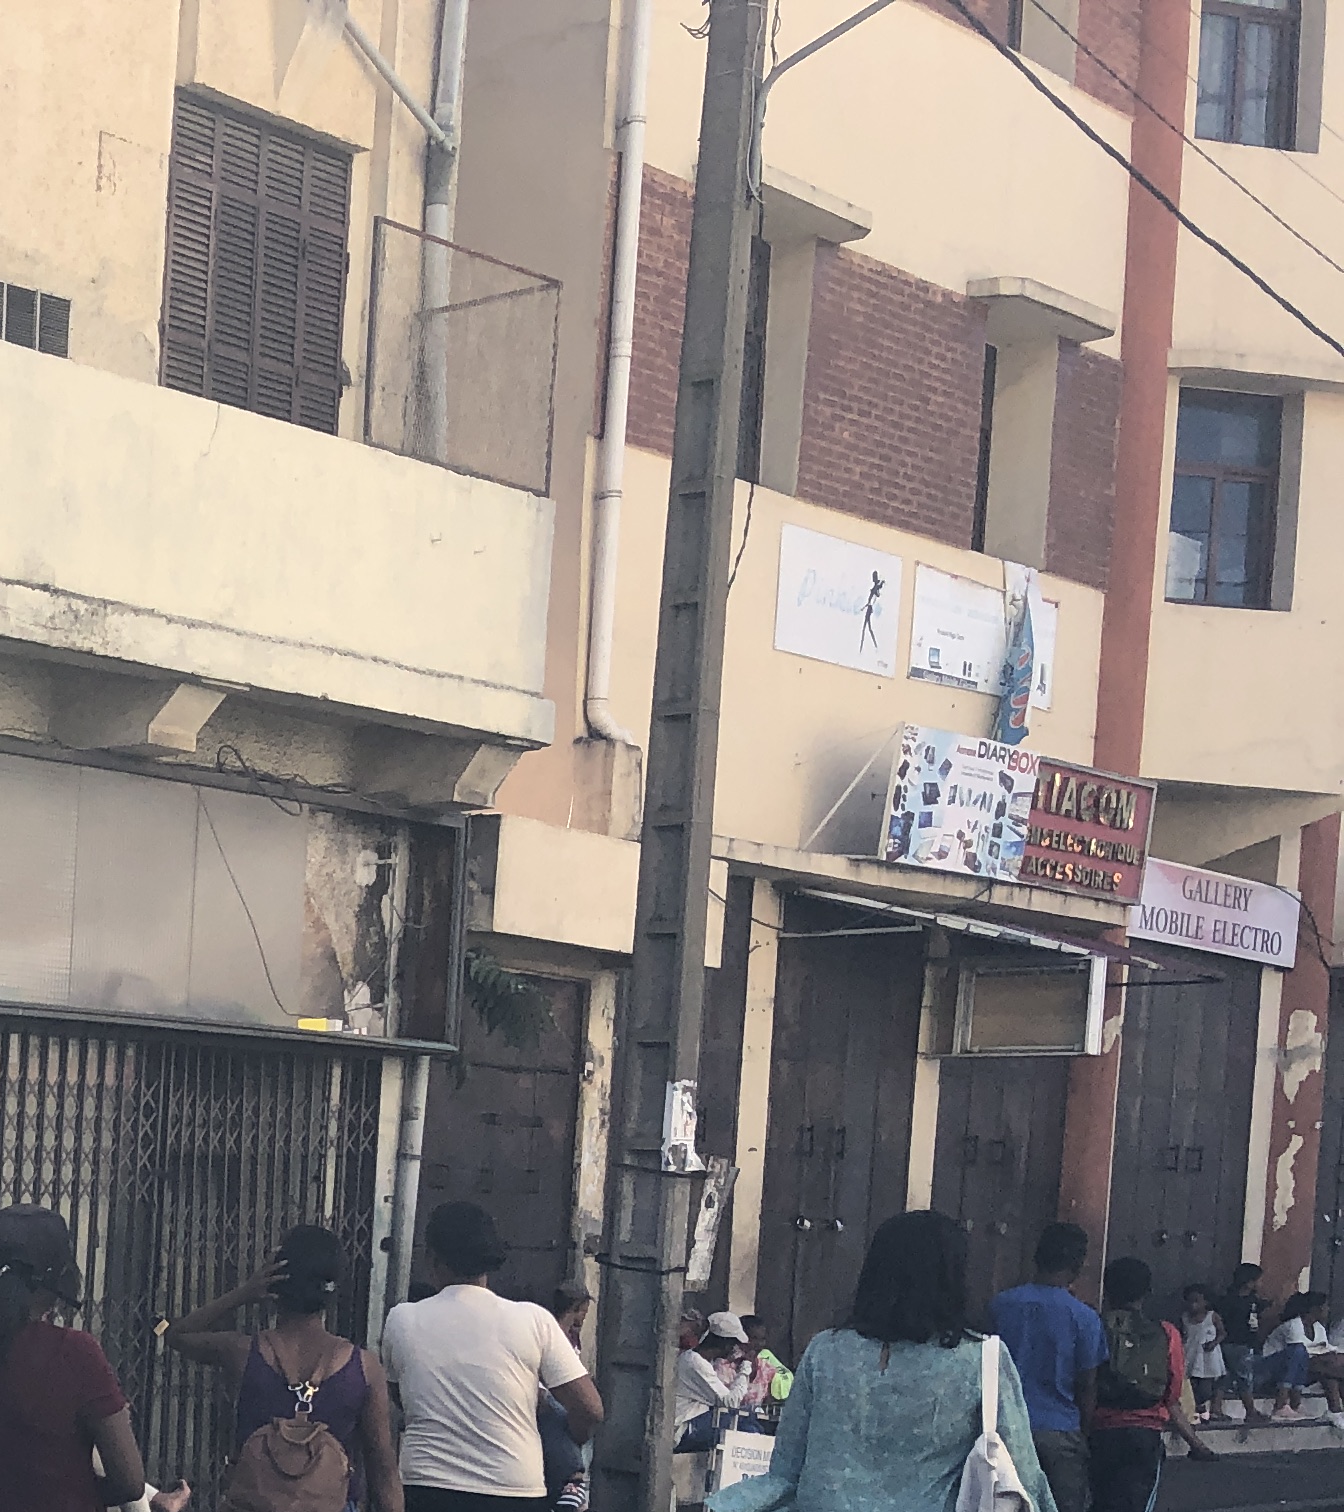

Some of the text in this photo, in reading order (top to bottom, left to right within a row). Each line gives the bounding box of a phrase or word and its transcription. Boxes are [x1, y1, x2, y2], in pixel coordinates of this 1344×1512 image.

[1026, 855, 1123, 891] ACCESSOIRES
[1182, 875, 1254, 912] GALLERY
[1139, 904, 1282, 956] MOBILE ELECTRO
